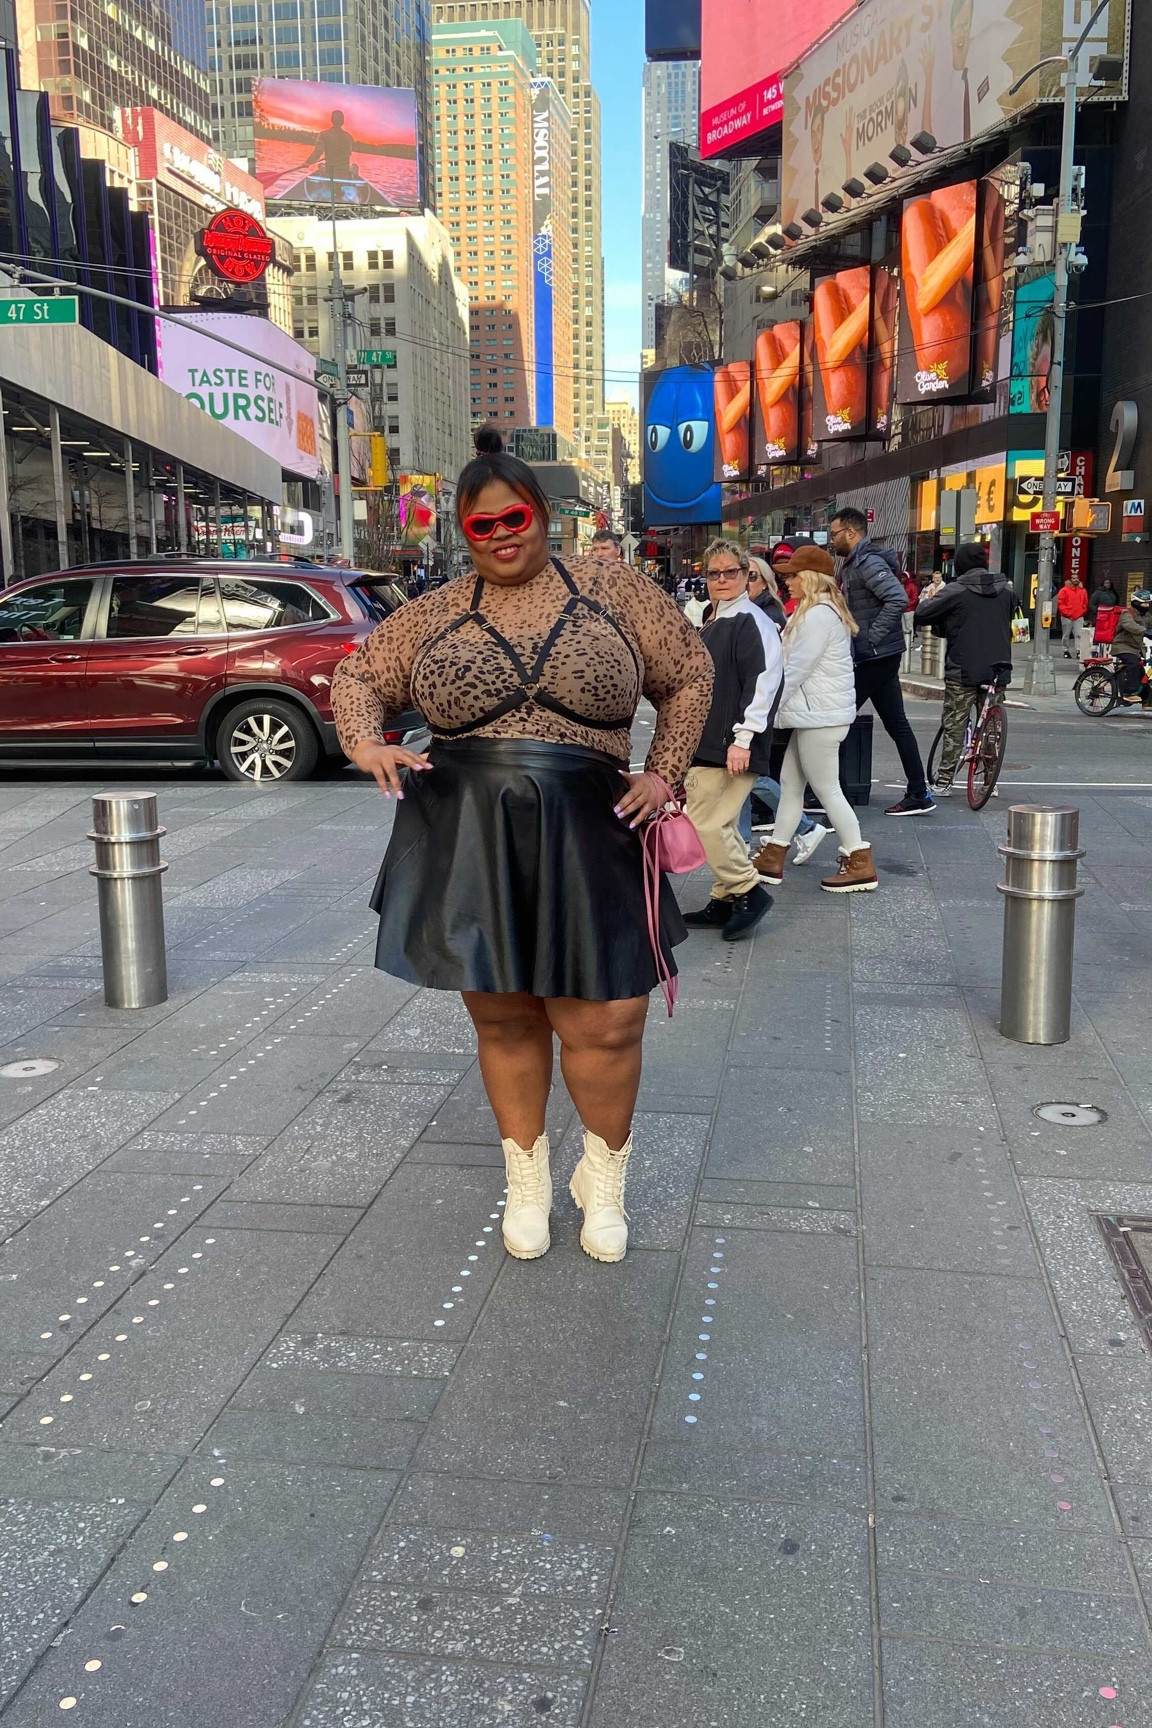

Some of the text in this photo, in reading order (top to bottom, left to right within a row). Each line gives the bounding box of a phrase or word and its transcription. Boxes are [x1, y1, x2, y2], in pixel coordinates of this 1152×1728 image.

[836, 4, 886, 62] MUSICAL
[763, 84, 777, 103] 145
[711, 101, 747, 127] MUSEUM OF
[857, 81, 918, 151] MORMN
[706, 111, 752, 145] BROADWAY
[221, 216, 253, 231] HOT
[207, 247, 271, 262] ORIGINAL GLAZED
[224, 258, 257, 277] NOW
[8, 302, 50, 320] 47 St
[371, 351, 382, 363] 47
[385, 351, 393, 359] St
[187, 368, 276, 392] TASTE FOR
[915, 371, 937, 383] Olive
[918, 380, 949, 394] Garden
[183, 391, 283, 428] OURSELF
[828, 422, 851, 434] Garden
[1105, 400, 1138, 493] 2
[1026, 482, 1068, 490] ONE AY
[1035, 517, 1056, 525] WRONG
